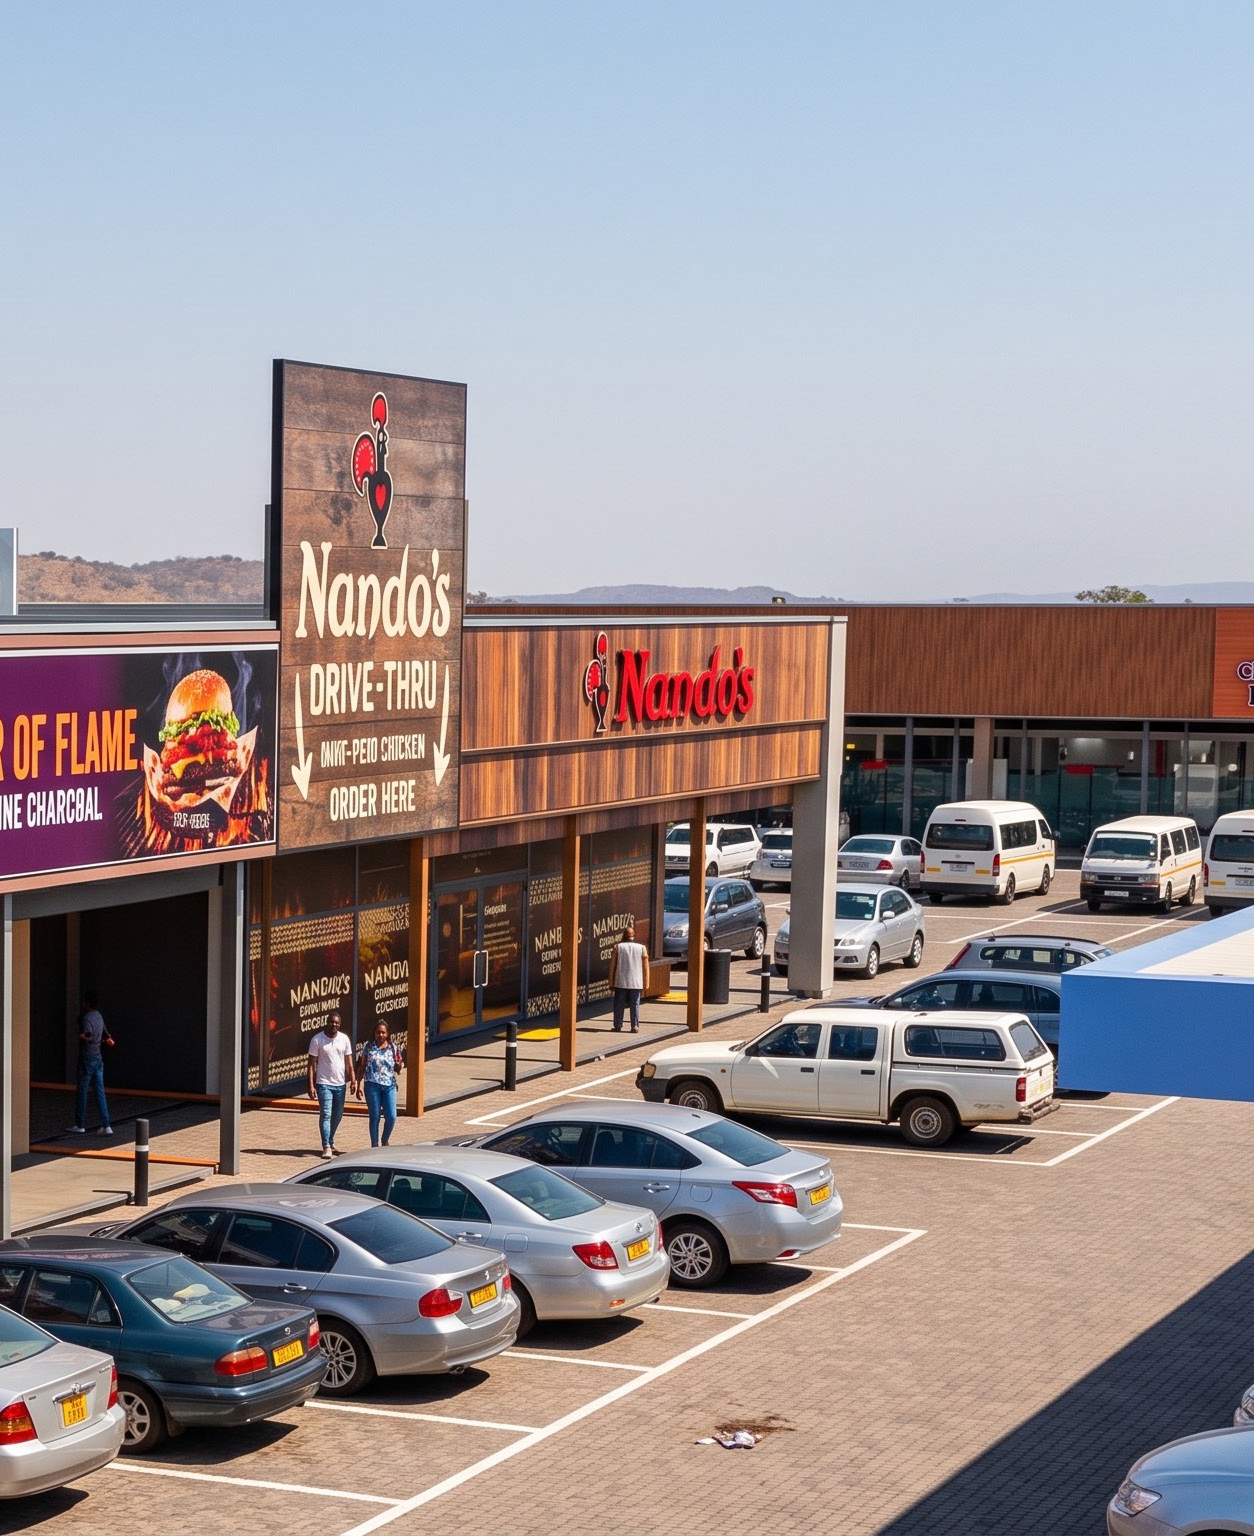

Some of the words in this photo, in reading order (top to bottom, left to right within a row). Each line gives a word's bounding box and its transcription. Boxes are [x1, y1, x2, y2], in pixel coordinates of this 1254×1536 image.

[295, 541, 450, 640] Nando's
[615, 644, 755, 722] Nando's
[13, 714, 47, 780] OF
[55, 709, 138, 777] FLAME
[330, 783, 377, 821] ORDER
[382, 779, 416, 814] HERE
